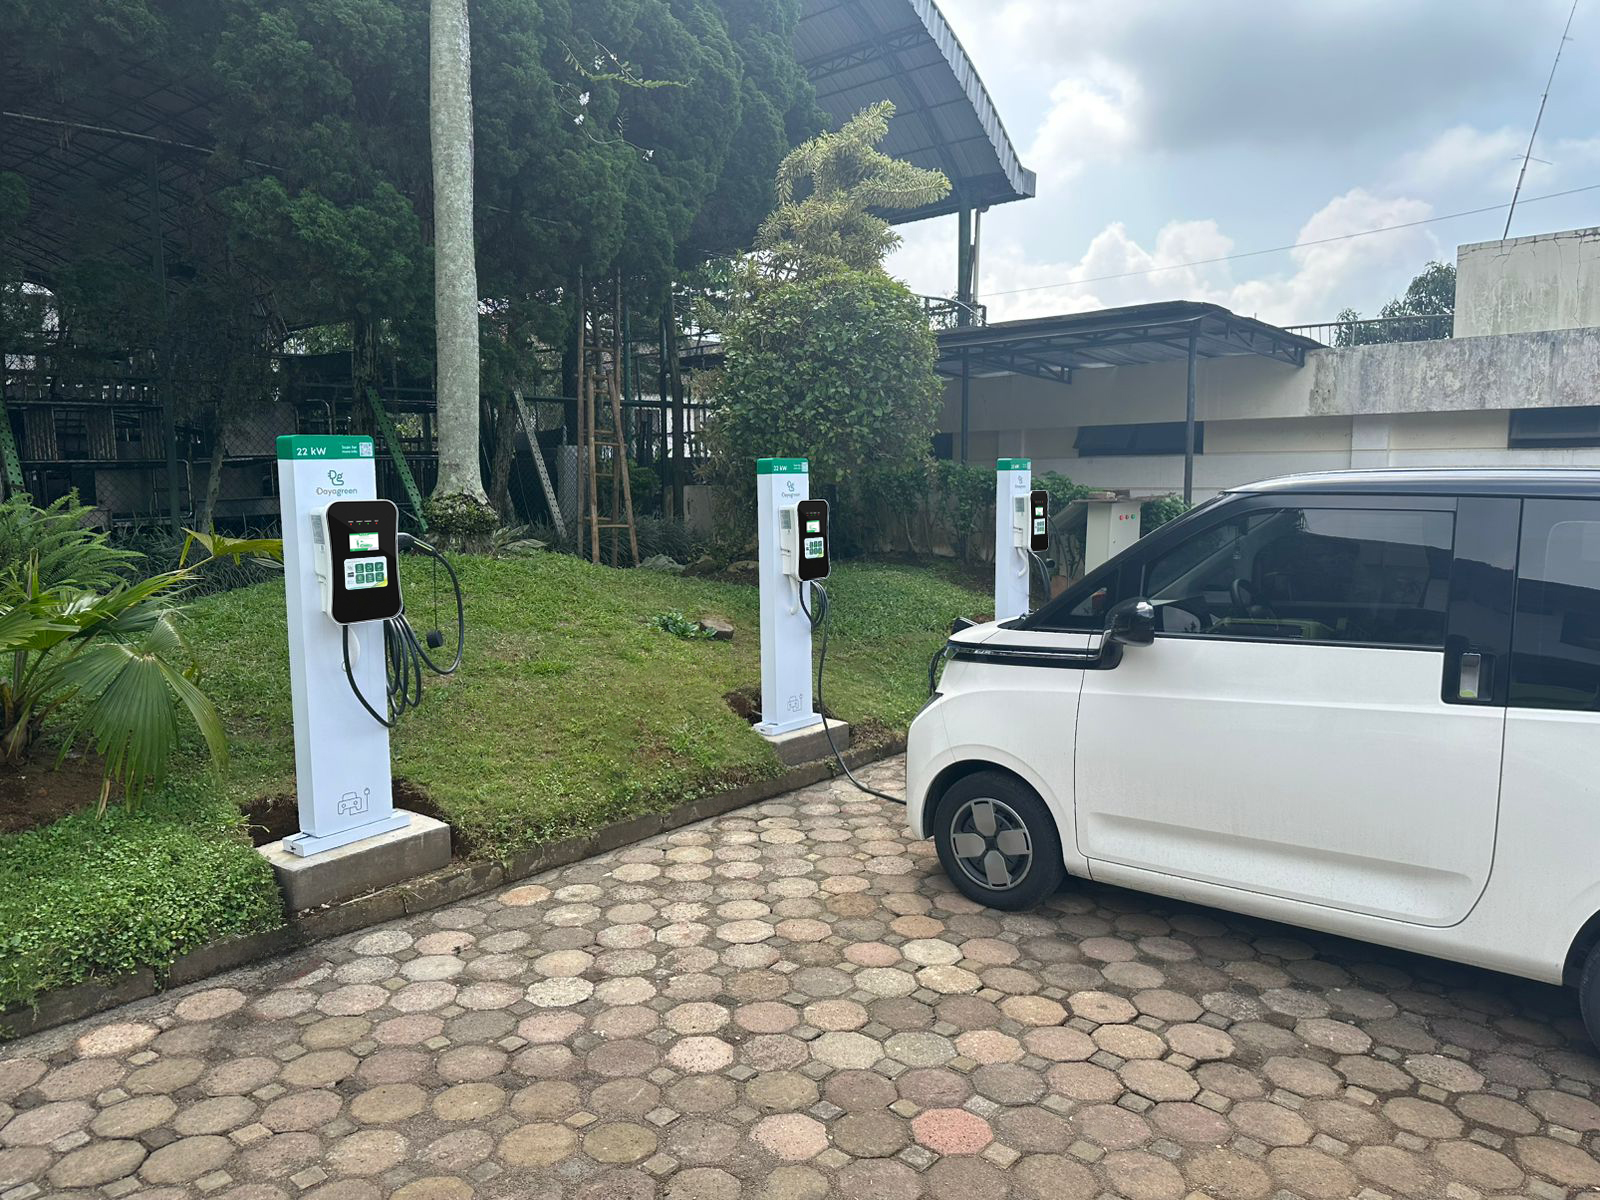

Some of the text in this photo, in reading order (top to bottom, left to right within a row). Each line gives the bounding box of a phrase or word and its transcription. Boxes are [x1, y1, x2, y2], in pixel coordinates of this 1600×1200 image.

[297, 447, 326, 456] 22 kW
[316, 487, 357, 497] Dayagreen
